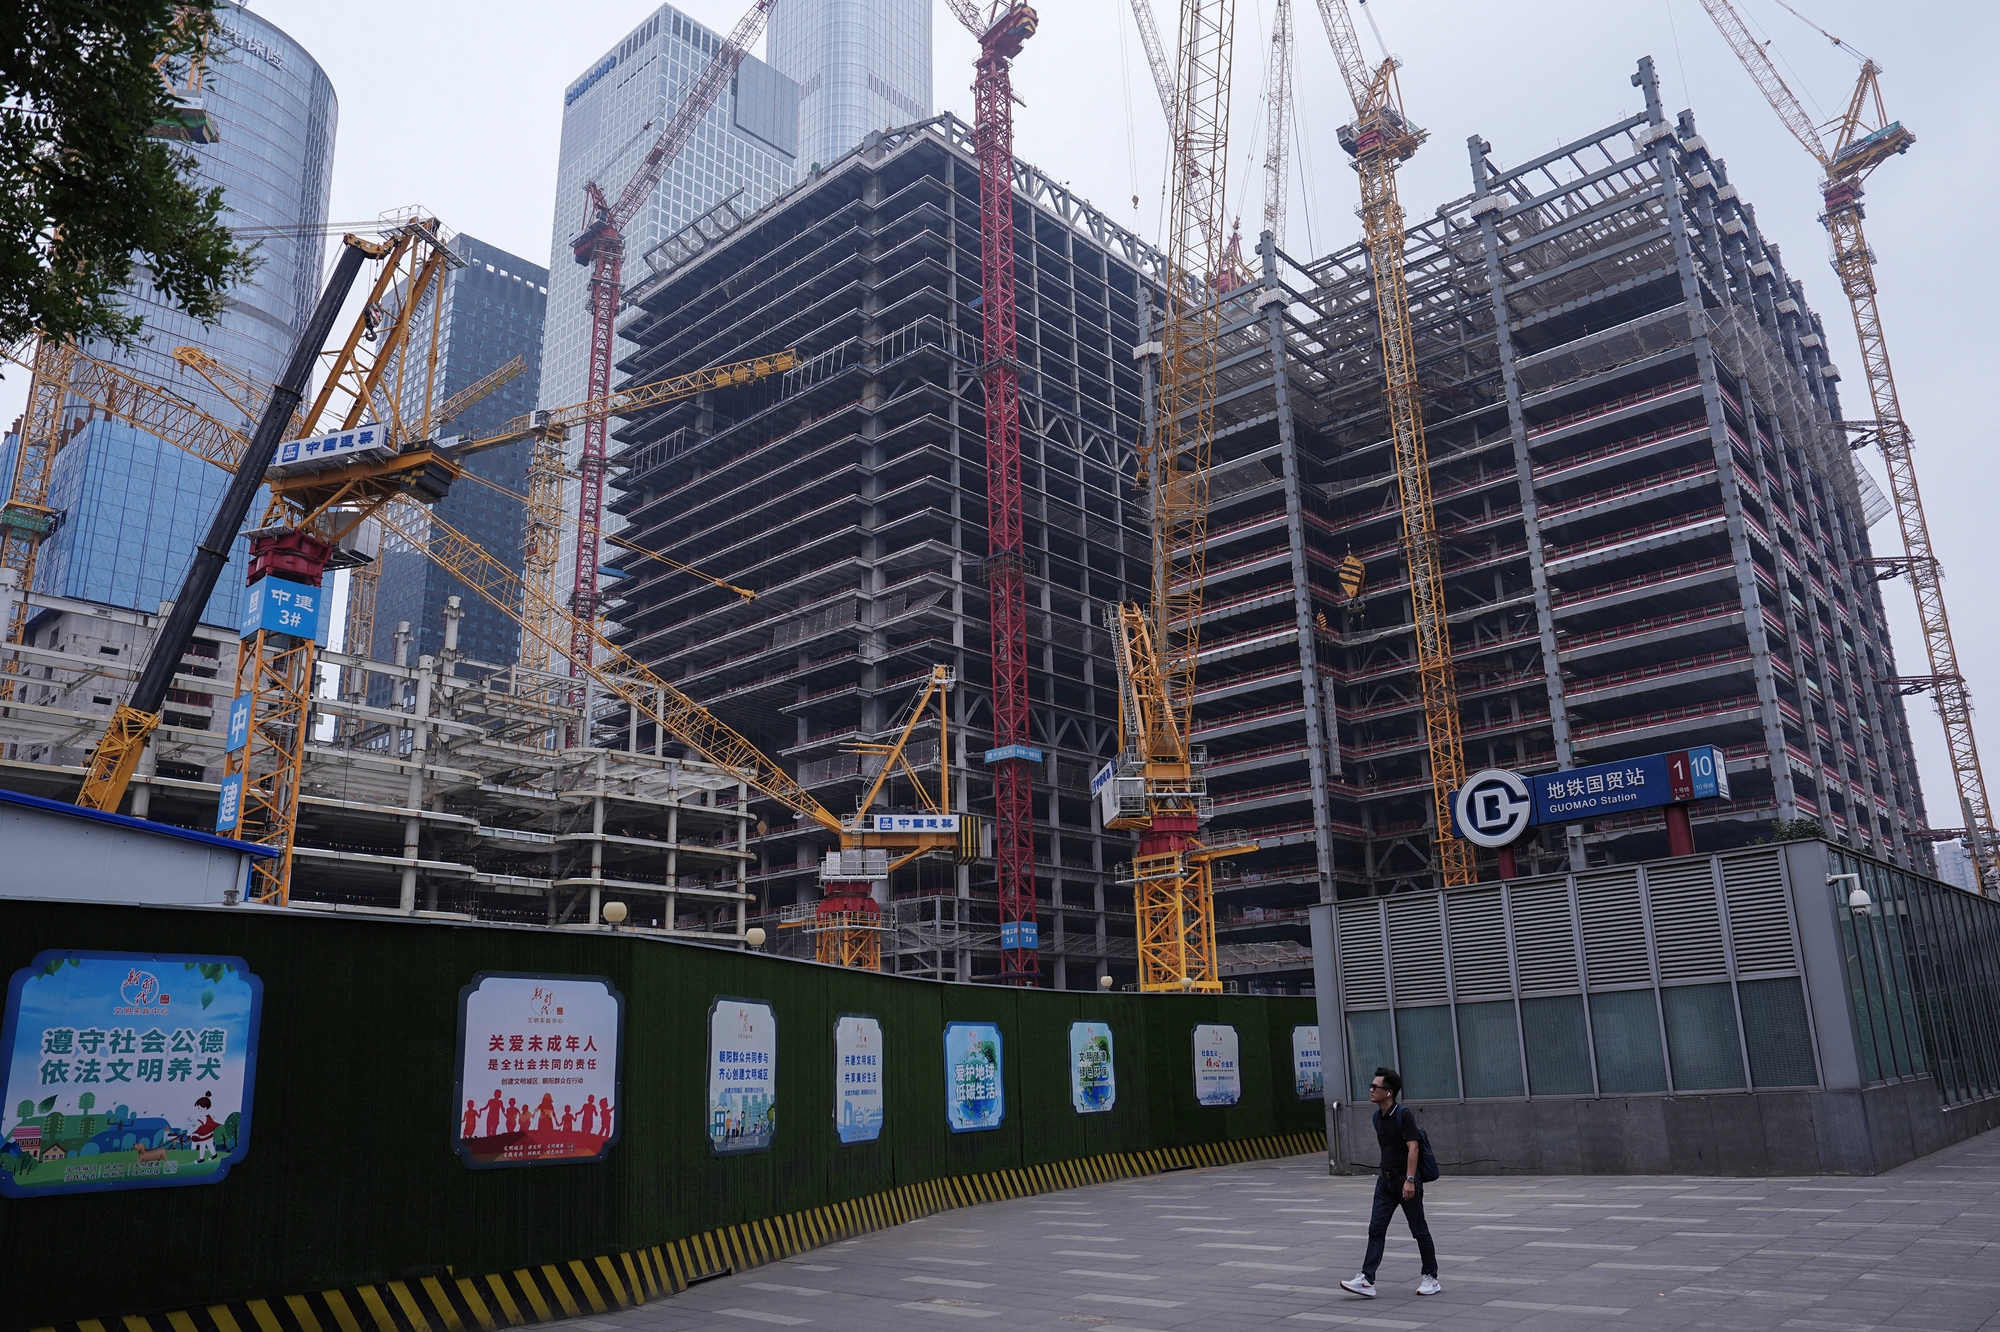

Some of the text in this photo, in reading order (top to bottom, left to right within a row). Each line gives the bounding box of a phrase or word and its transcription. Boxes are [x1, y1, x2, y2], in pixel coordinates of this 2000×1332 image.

[565, 55, 617, 106] SAMSUNG
[271, 589, 314, 612] 中建
[279, 609, 301, 627] 3#
[219, 703, 248, 824] 中 建
[1673, 760, 1684, 780] 1
[1691, 756, 1712, 777] 10
[1546, 767, 1645, 800] 地铁国贸站
[1549, 792, 1637, 814] GUOMAO Station
[113, 1006, 169, 1016] 文明实践中心
[43, 1028, 226, 1055] 遵守社会公德
[488, 1034, 598, 1052] 关爱未成年人
[488, 1058, 597, 1071] 是全社会共同的责任
[719, 1050, 769, 1063] 朝阳群众共同参与
[845, 1055, 877, 1066] 共建文明城区
[1078, 1050, 1107, 1063] 文明健康
[1206, 1057, 1220, 1068] 核心
[40, 1057, 222, 1085] 依法文明养犬
[719, 1068, 769, 1080] 齐心创建文明城区
[844, 1072, 877, 1083] 共享美好生活
[955, 1064, 995, 1082] 爱护地球
[1078, 1066, 1108, 1078] 绿色环保
[501, 1077, 583, 1085] 创建文明城区 朝阳群众在行动
[955, 1082, 996, 1101] 低碳生活
